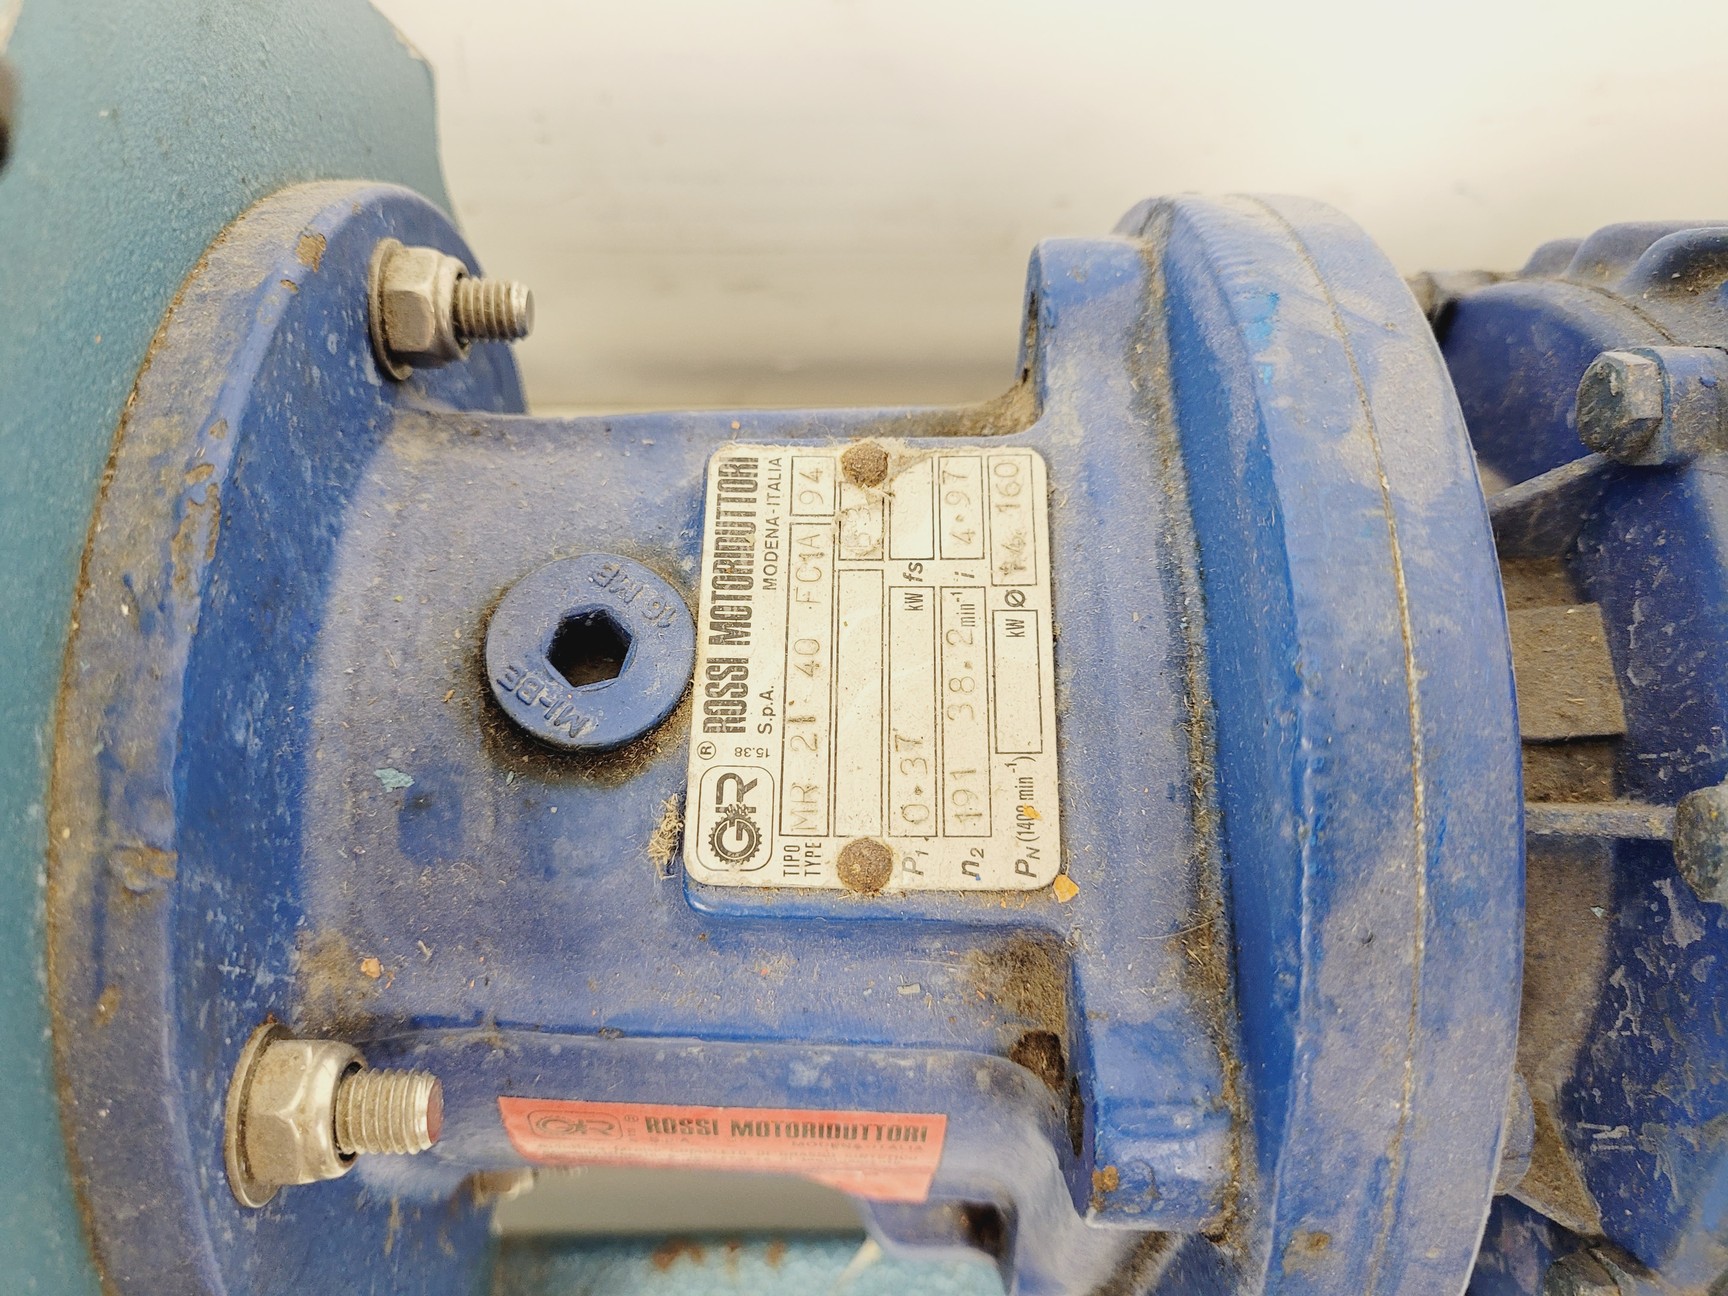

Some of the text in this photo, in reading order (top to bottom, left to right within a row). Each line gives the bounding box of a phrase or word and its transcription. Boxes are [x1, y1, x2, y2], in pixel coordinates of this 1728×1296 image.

[799, 467, 825, 505] 94
[994, 462, 1021, 513] 160
[902, 561, 924, 582] fs
[703, 456, 759, 734] ROSSI MOTORIDUTTORI
[904, 592, 924, 611] kW
[1005, 618, 1026, 638] kW
[757, 685, 775, 735] S.p.A.
[734, 746, 771, 758] 15.38
[790, 782, 819, 832] MR
[951, 768, 983, 824] 191
[782, 843, 801, 877] TIPO
[803, 841, 822, 877] TYPE
[645, 1115, 719, 1137] ROSSI
[731, 1119, 928, 1143] MOTORIDUTTORI
